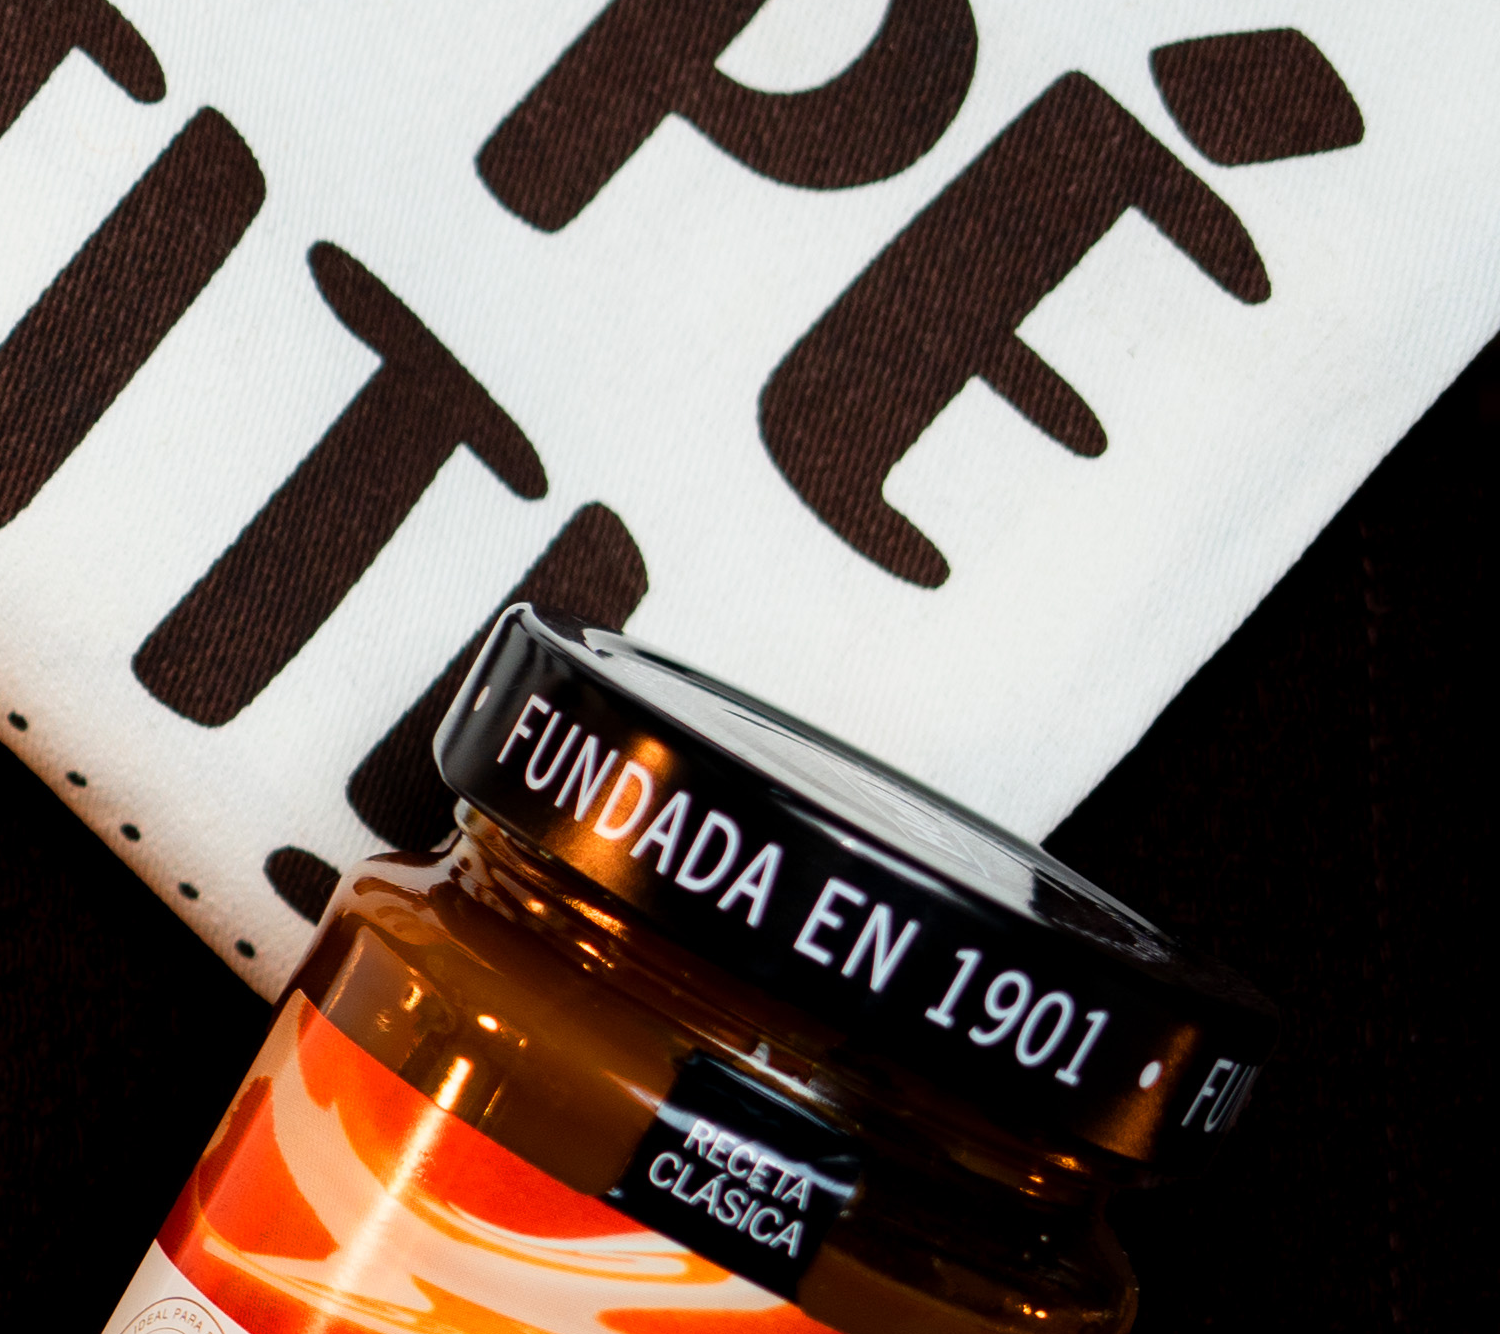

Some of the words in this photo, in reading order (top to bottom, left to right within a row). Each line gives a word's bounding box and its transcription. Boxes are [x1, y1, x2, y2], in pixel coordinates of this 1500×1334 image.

[496, 694, 783, 929] FUNDADA
[793, 876, 921, 994] EN
[924, 948, 1111, 1086] 1901
[648, 1151, 804, 1259] CLÁSICA
[683, 1118, 814, 1211] RECETA
[172, 1307, 203, 1333] PARA
